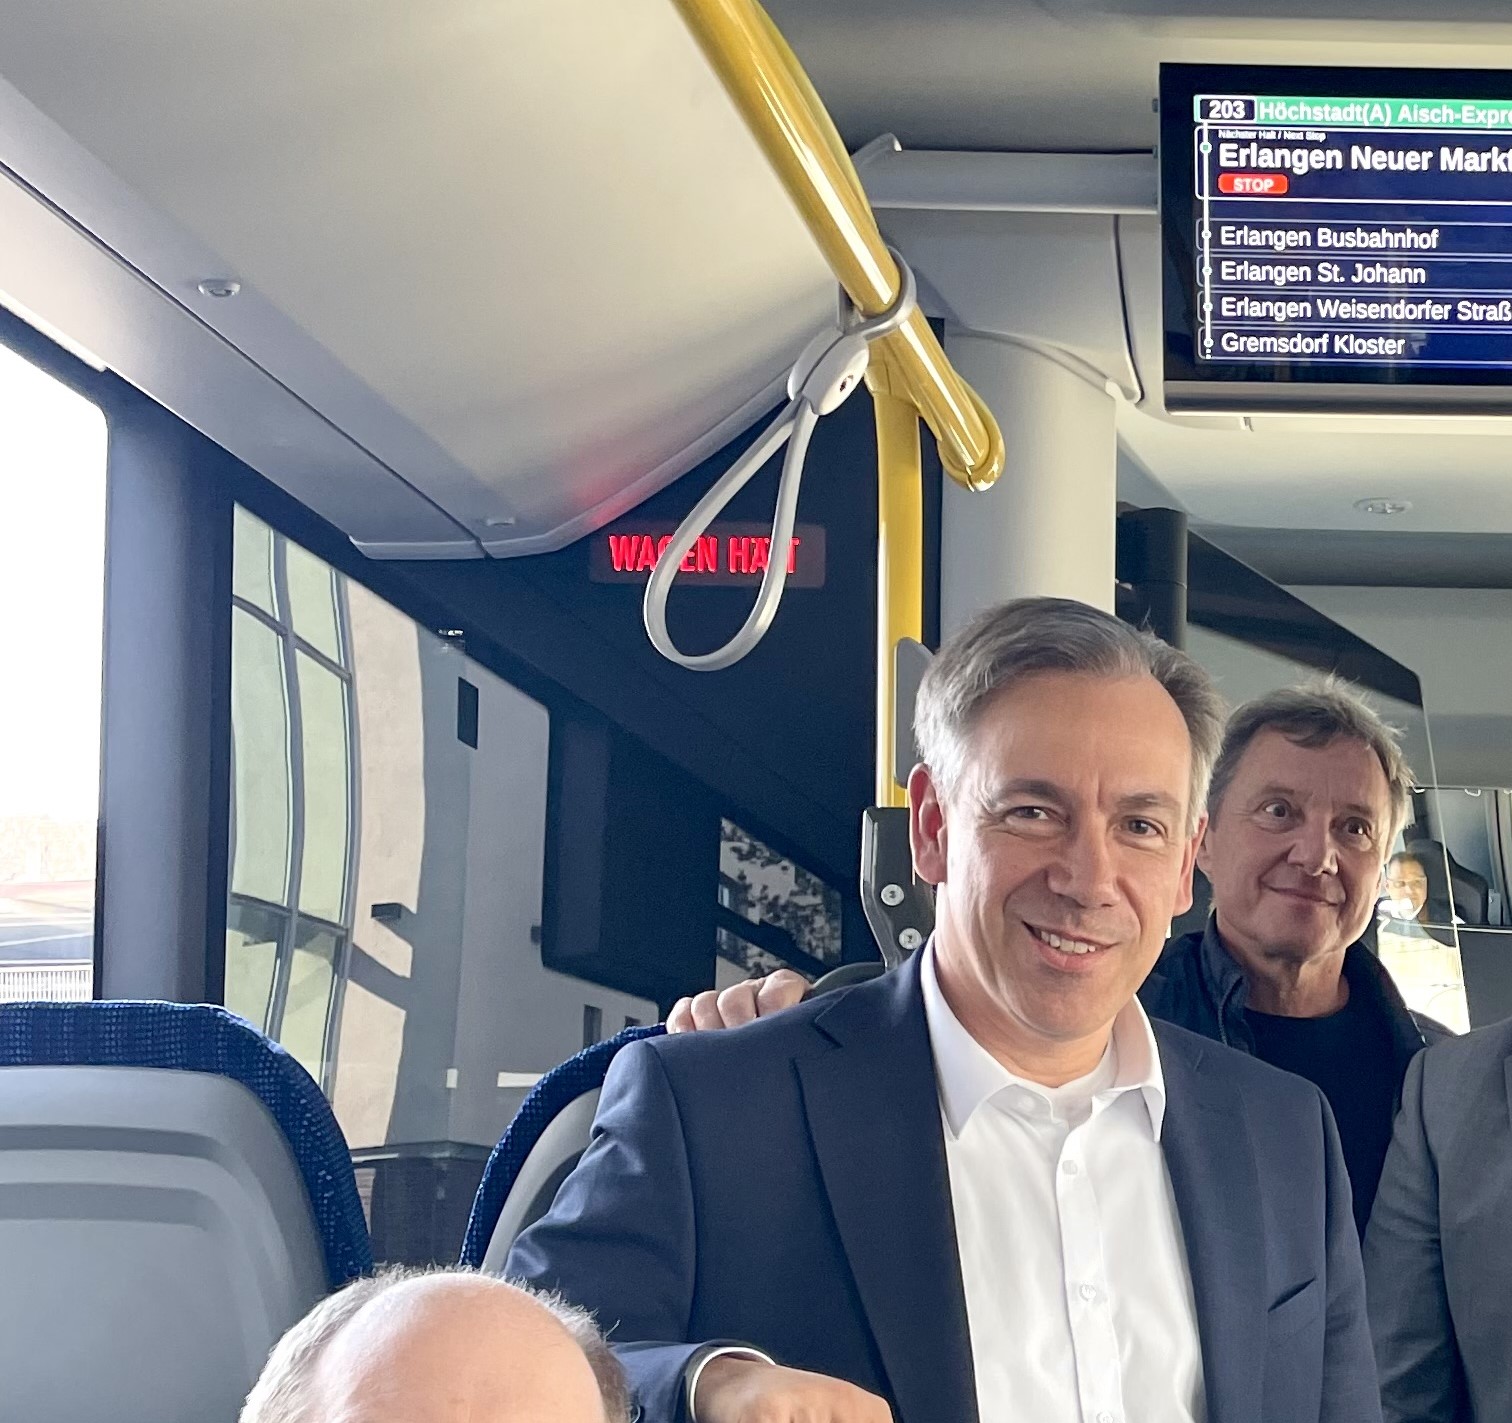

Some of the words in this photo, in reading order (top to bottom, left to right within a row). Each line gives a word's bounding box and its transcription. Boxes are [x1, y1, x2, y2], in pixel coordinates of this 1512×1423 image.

[1209, 99, 1246, 119] 203
[1259, 102, 1393, 127] Höchstadt(A)
[1219, 142, 1343, 175] Erlangen
[1351, 145, 1434, 171] Neuer
[1233, 177, 1275, 193] STOP
[1220, 225, 1312, 251] Erlangen
[1317, 227, 1440, 249] Busbahnhof
[1221, 260, 1312, 286] Erlangen
[1317, 262, 1345, 283] St.
[1351, 263, 1426, 284] Johann
[1221, 296, 1312, 322] Erlangen
[1316, 298, 1452, 320] Weisendorfer
[1221, 332, 1329, 353] Gremsdorf
[1334, 333, 1406, 355] Kloster
[728, 536, 801, 574] HÄT
